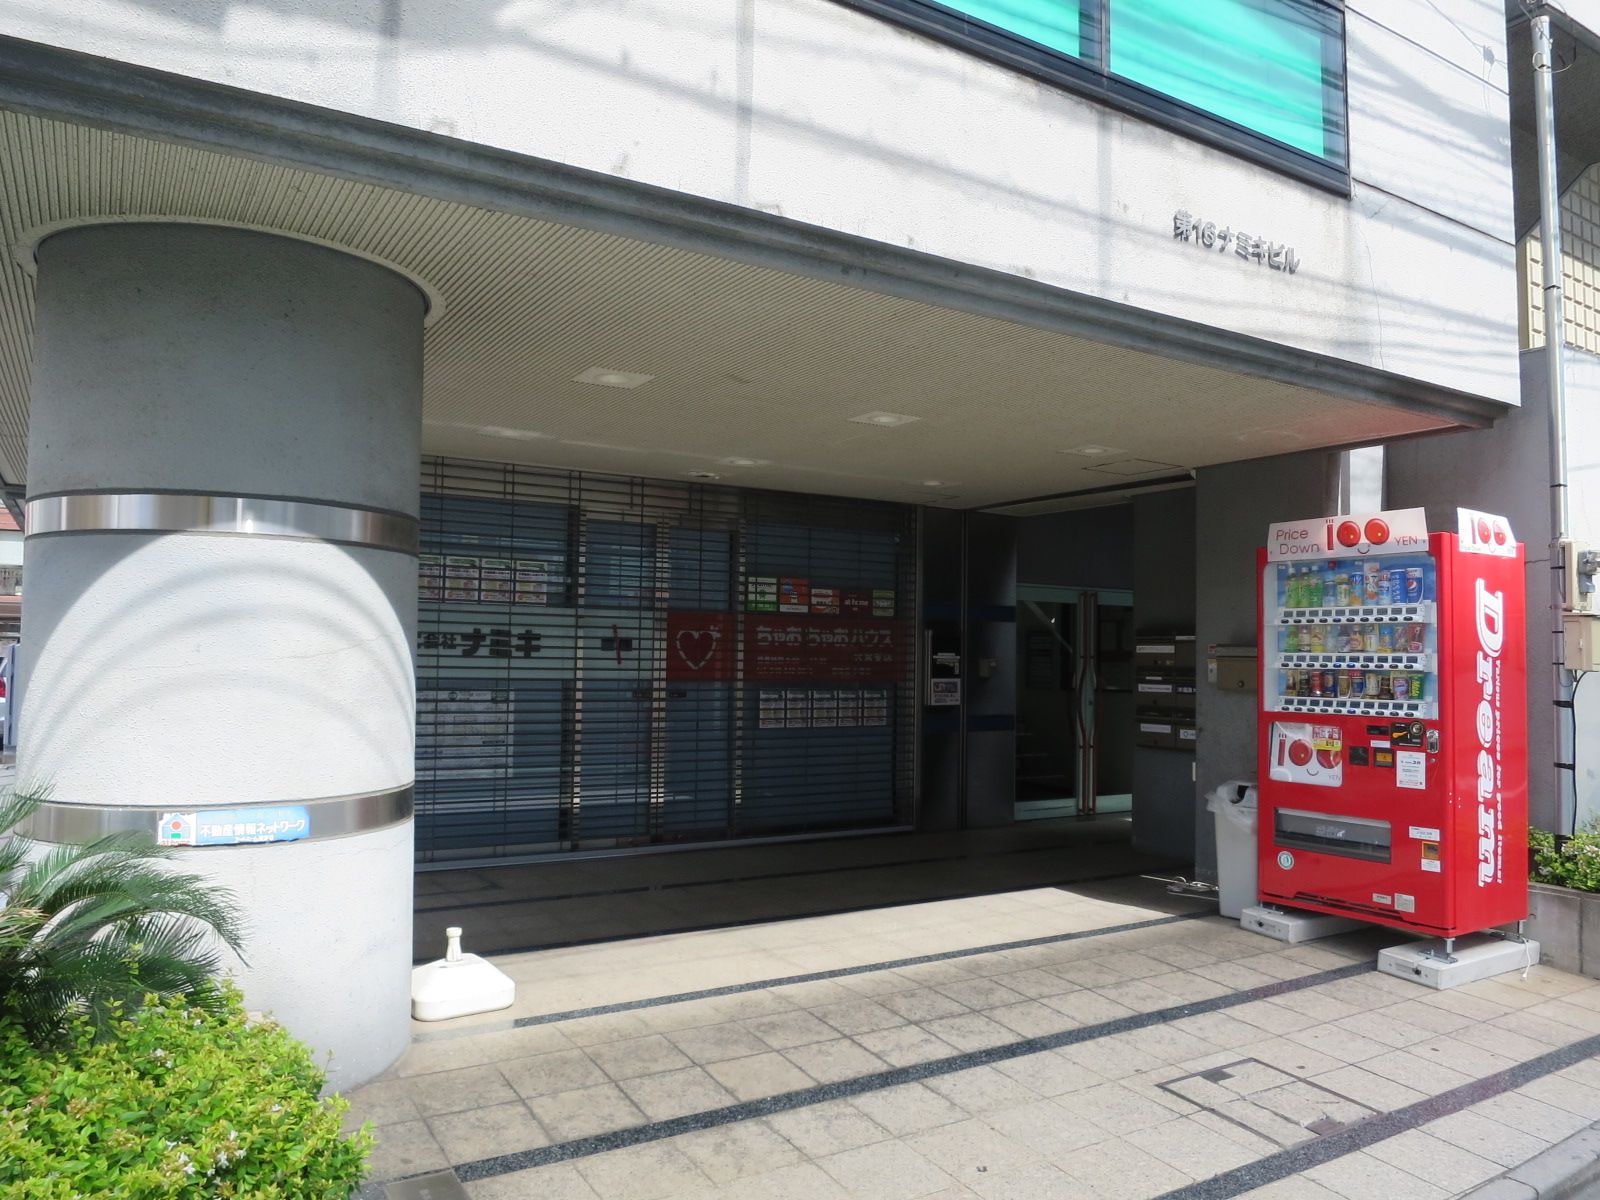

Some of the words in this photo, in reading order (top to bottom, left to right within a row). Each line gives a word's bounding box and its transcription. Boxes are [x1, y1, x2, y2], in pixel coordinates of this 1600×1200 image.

[1173, 209, 1300, 275] 第16ナミキビル
[1276, 528, 1309, 541] Price
[1325, 517, 1390, 551] 100
[1394, 535, 1418, 547] YEN
[1470, 513, 1507, 546] 100
[1279, 542, 1320, 555] Down
[1476, 577, 1504, 887] Dream
